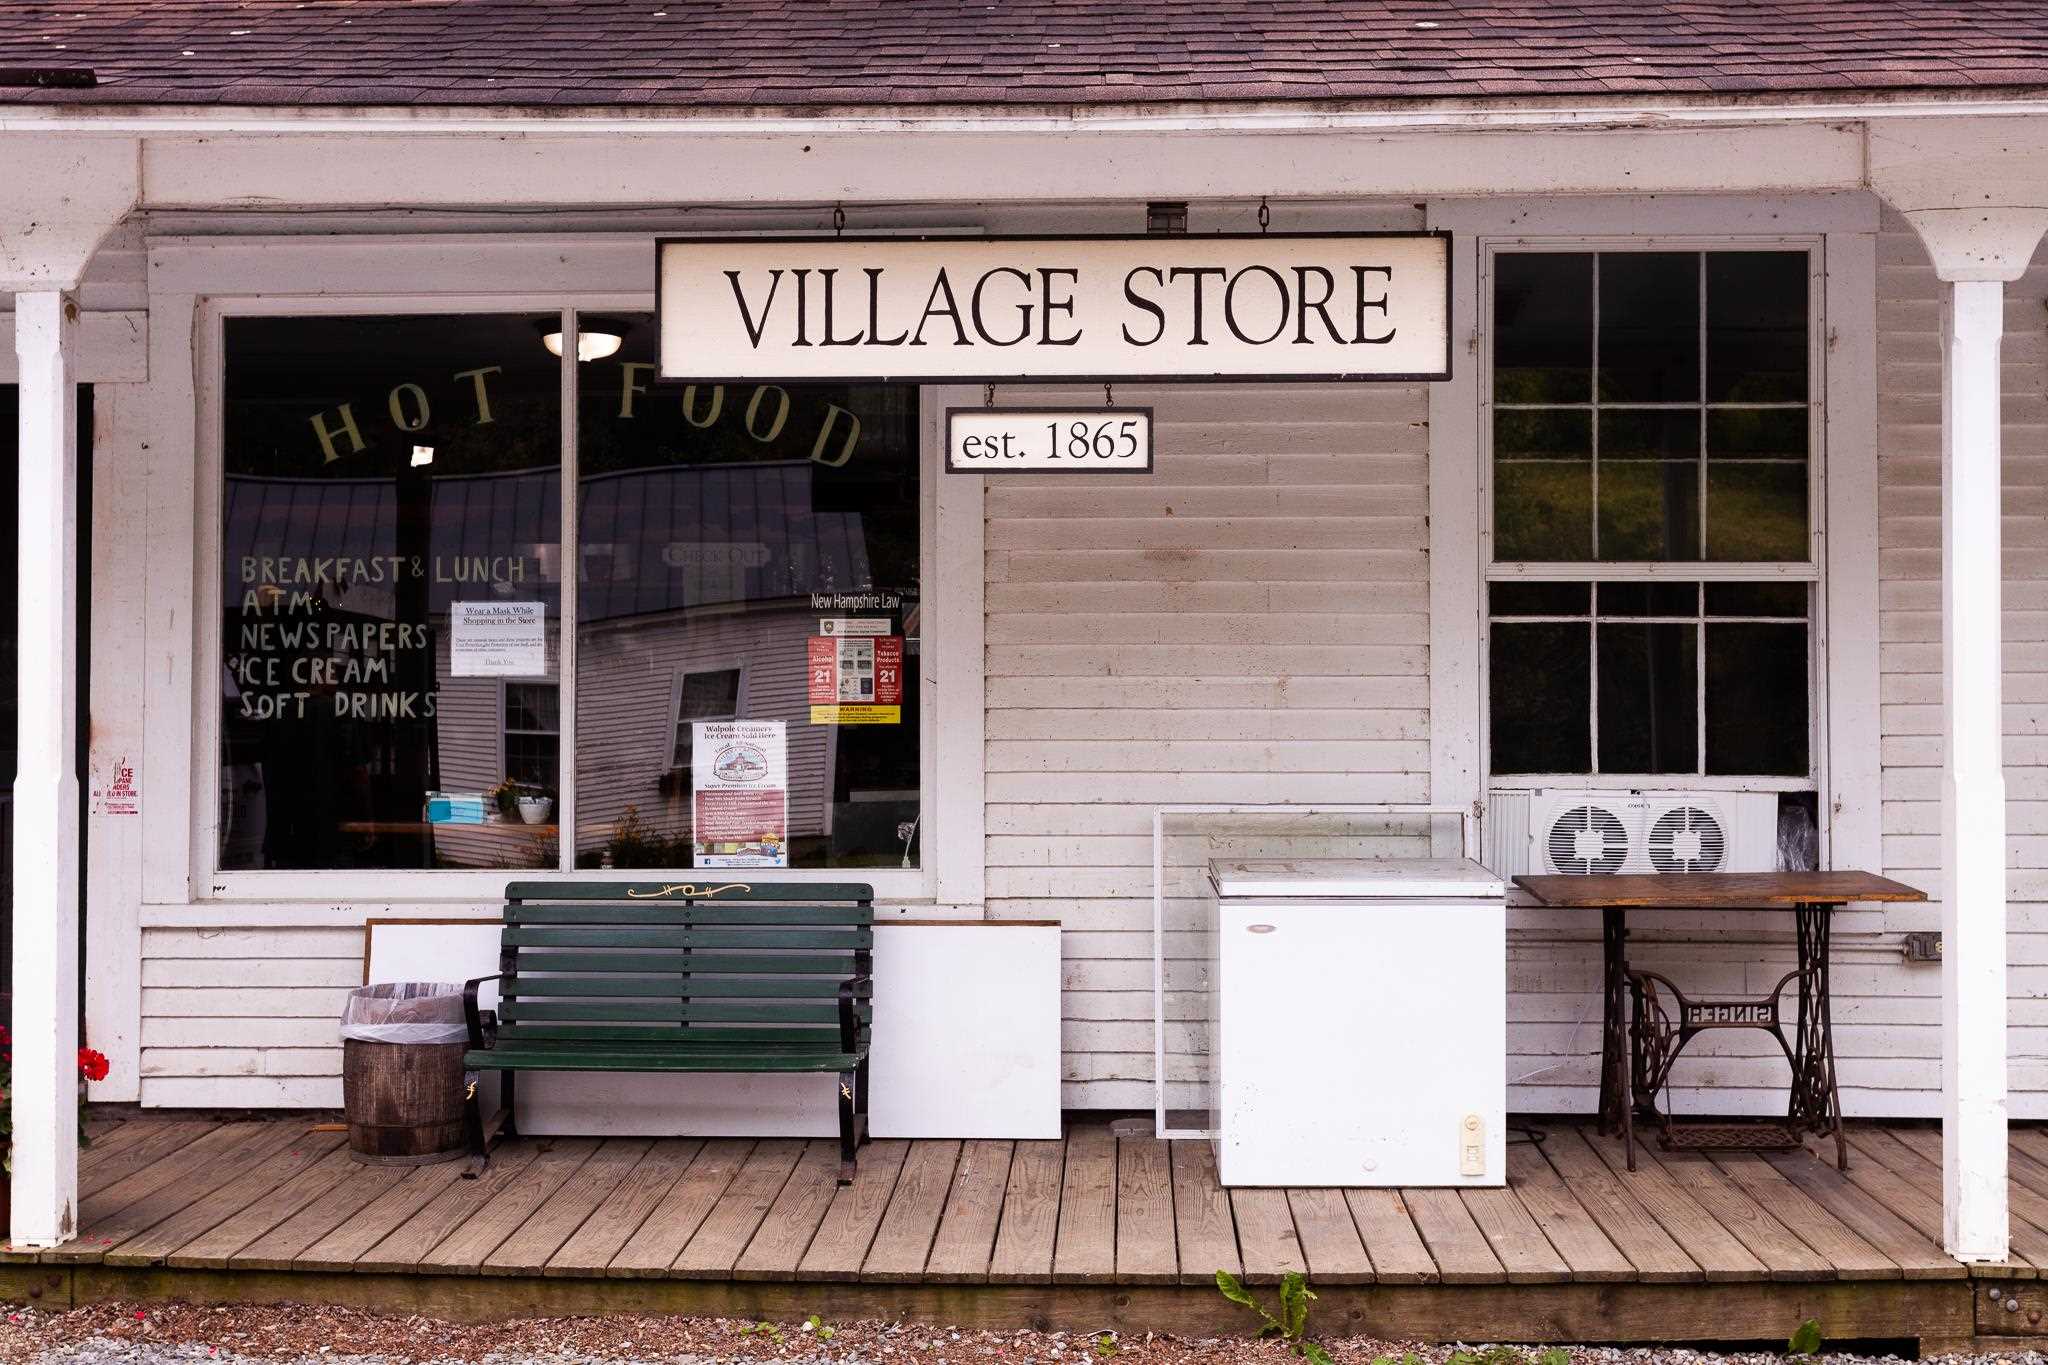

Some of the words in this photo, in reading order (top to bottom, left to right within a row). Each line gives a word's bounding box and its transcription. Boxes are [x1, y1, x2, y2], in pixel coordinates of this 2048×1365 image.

[723, 265, 1083, 349] VILLAGE
[1121, 265, 1397, 346] STORE
[308, 364, 502, 465] HOT
[617, 362, 862, 469] FOOD
[961, 425, 1026, 460] est.
[1045, 419, 1141, 460] 1865
[241, 556, 406, 584] BREAKFAST
[411, 556, 425, 577] &
[436, 556, 525, 583] LUNCH
[242, 589, 314, 617] ATM
[465, 607, 485, 615] Wear
[492, 607, 511, 615] Mask
[513, 606, 535, 615] While
[811, 592, 833, 609] New
[834, 592, 880, 613] Hampshire
[881, 592, 900, 609] Law
[463, 617, 496, 626] Shopping
[518, 617, 536, 625] Store
[241, 623, 428, 651] NEWSPAPERS
[238, 652, 281, 686] ICE
[292, 657, 388, 685] CREAM
[812, 655, 834, 663] Alcohol
[814, 669, 831, 684] 21
[879, 669, 896, 684] 21
[240, 691, 311, 720] SOFT
[335, 691, 437, 719] DRINKS
[705, 725, 735, 734] Walpole
[736, 726, 772, 735] Creamery
